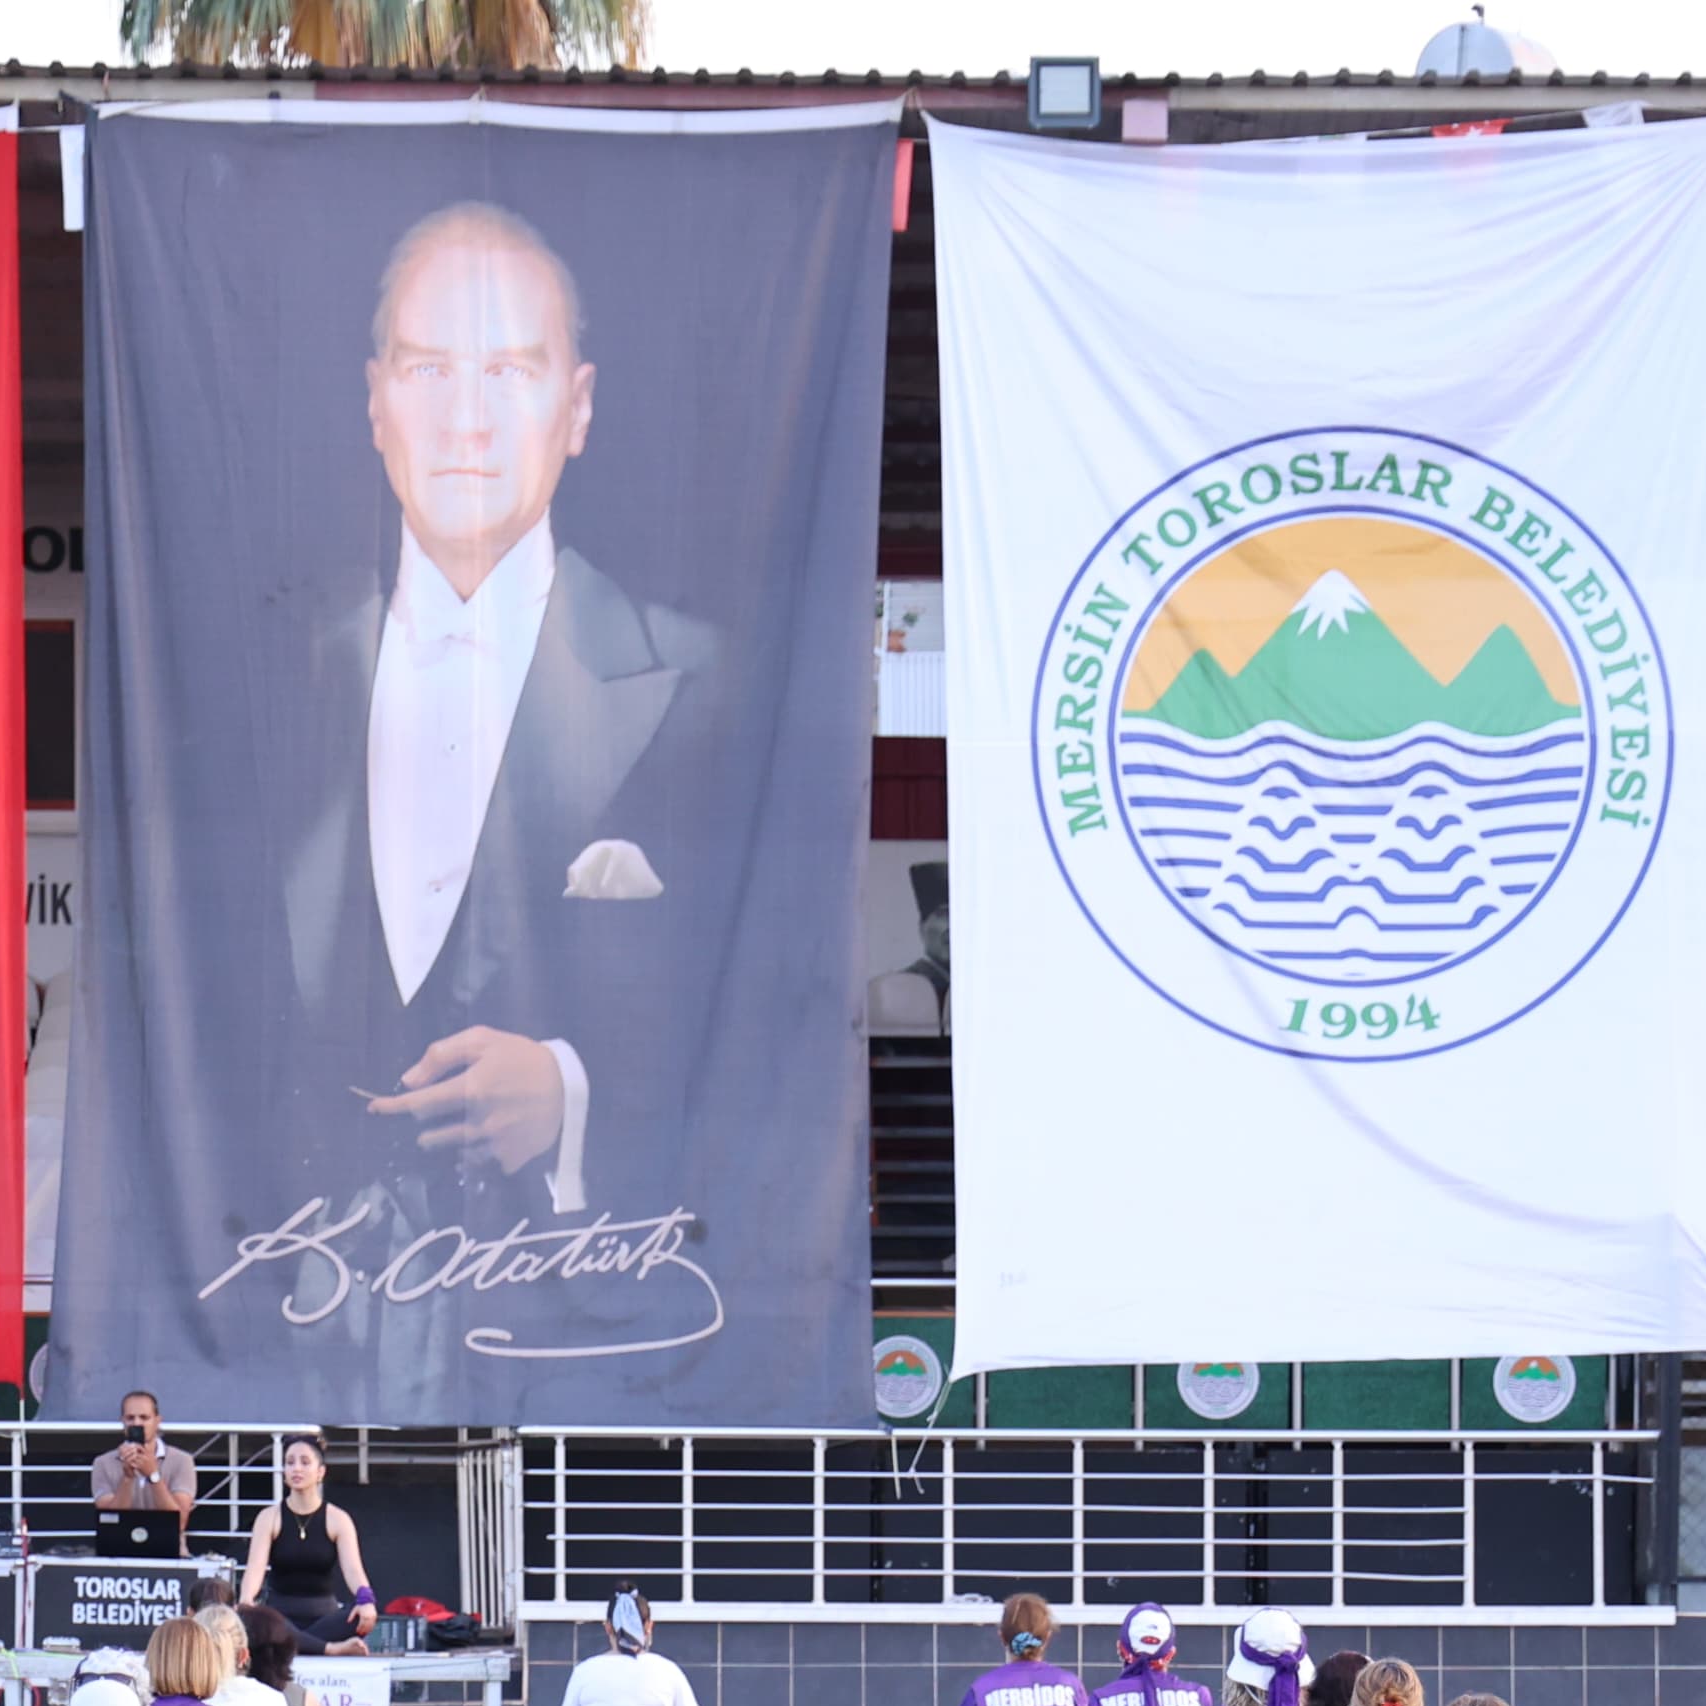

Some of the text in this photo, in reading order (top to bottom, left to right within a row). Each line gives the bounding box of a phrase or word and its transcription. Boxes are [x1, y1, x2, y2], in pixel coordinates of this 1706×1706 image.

[1054, 449, 1653, 838] MERSİN TOROSLAR BELEDİYESİ
[1279, 992, 1442, 1040] 1994
[74, 1576, 181, 1600] TOROSLAR
[72, 1600, 182, 1626] BELEDİYESİ
